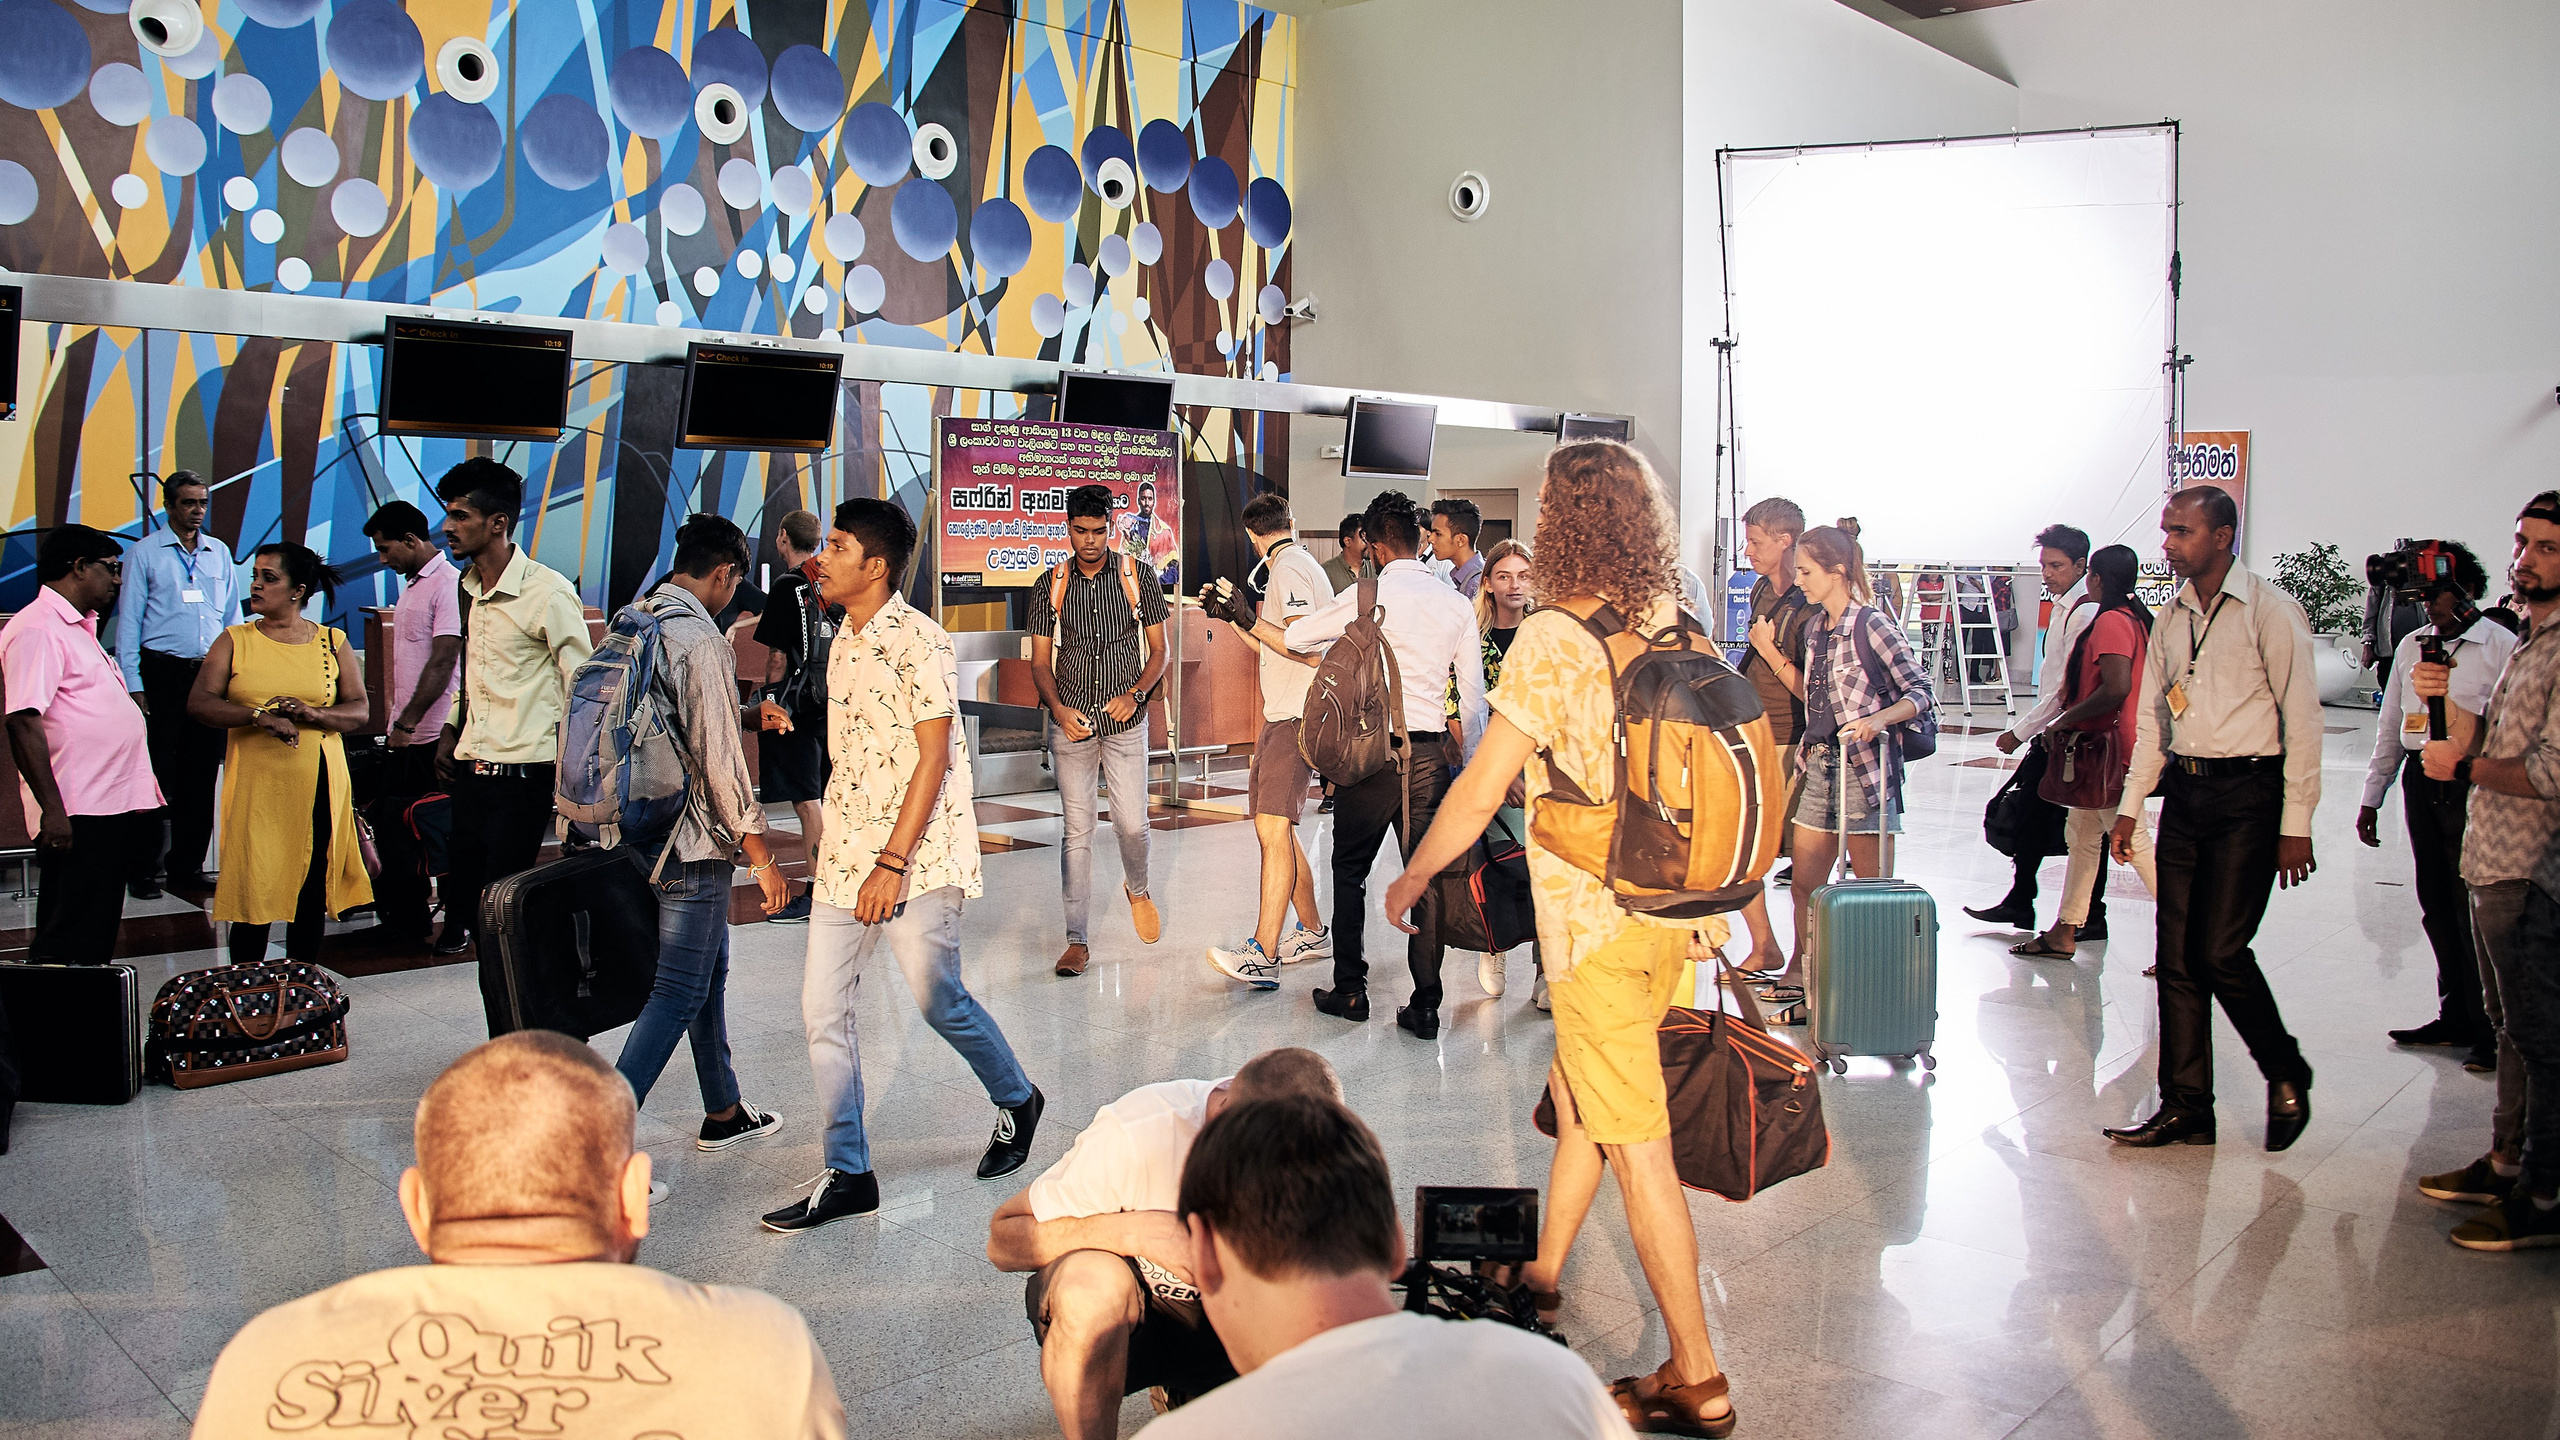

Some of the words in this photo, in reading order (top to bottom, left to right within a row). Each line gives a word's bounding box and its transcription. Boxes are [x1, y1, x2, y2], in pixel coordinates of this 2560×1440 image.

[419, 328, 448, 339] Check
[544, 340, 562, 348] 10:19
[716, 353, 740, 363] Check
[818, 362, 834, 370] 10:19
[1060, 428, 1072, 438] 13
[1728, 586, 1744, 595] Business
[389, 1312, 671, 1385] Quik
